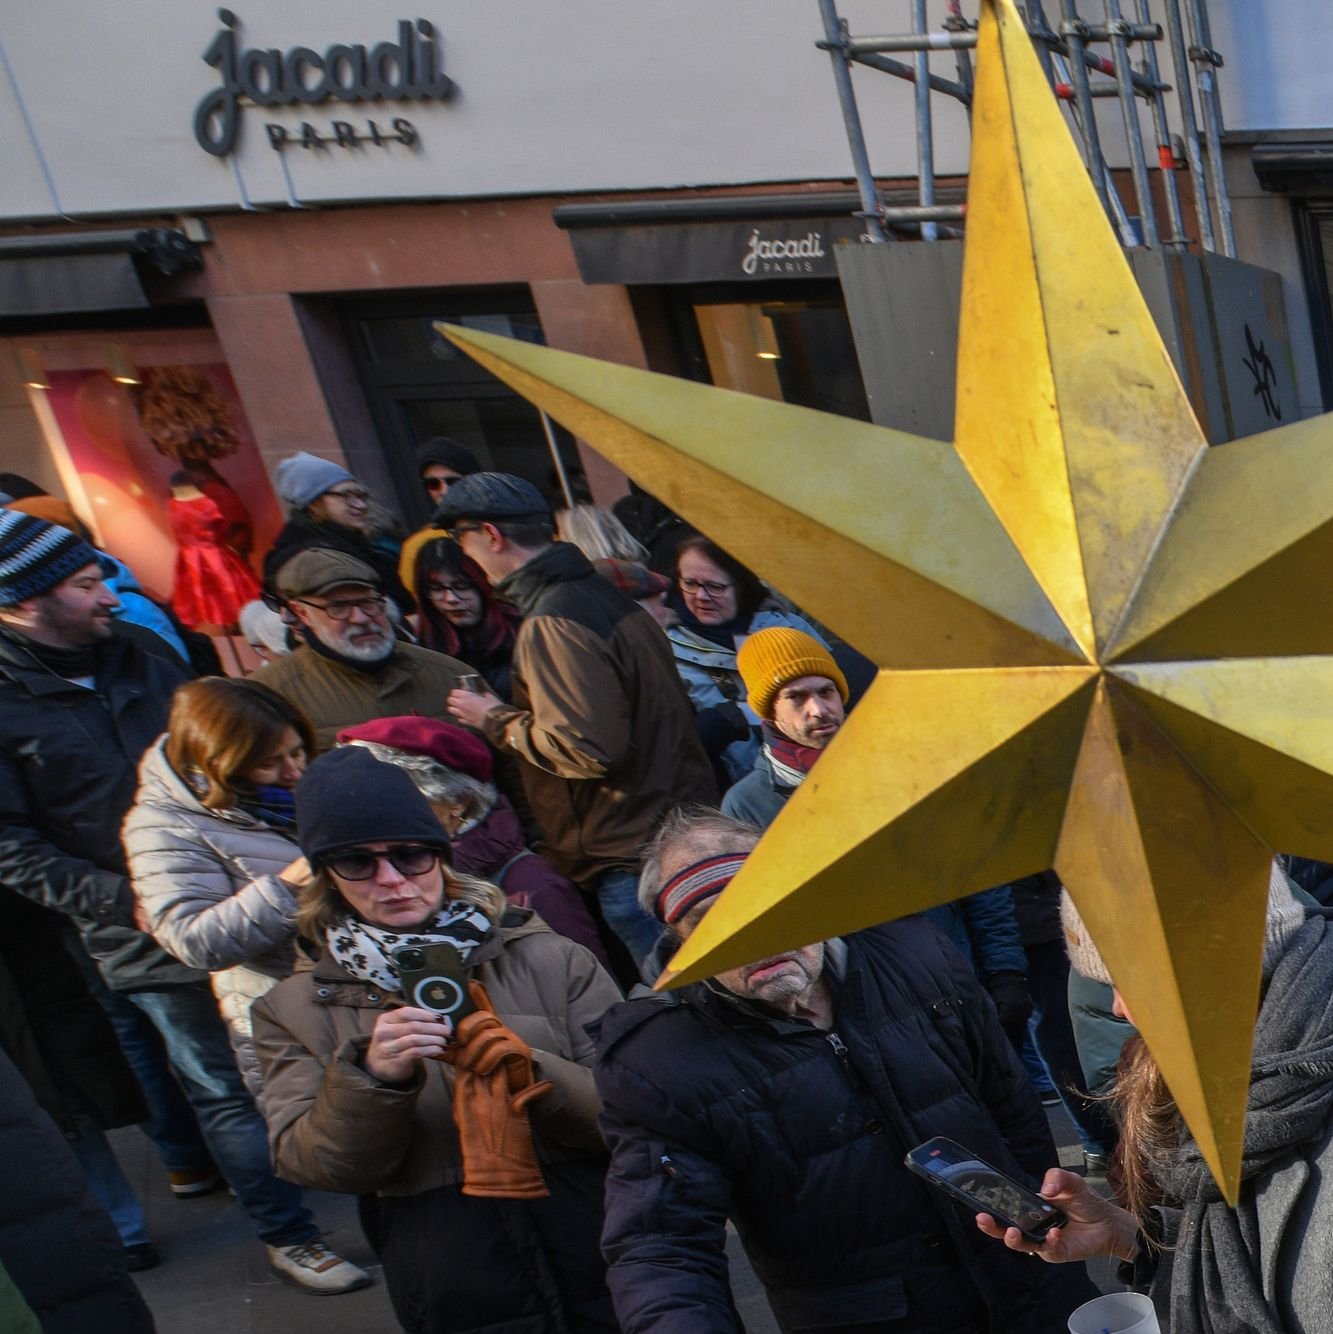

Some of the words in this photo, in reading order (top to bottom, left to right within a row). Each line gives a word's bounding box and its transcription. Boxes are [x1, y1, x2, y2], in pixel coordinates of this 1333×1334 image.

[194, 8, 457, 156] jacadi
[265, 117, 417, 151] PARIS
[743, 228, 824, 274] jacadi
[763, 262, 813, 272] PARIS
